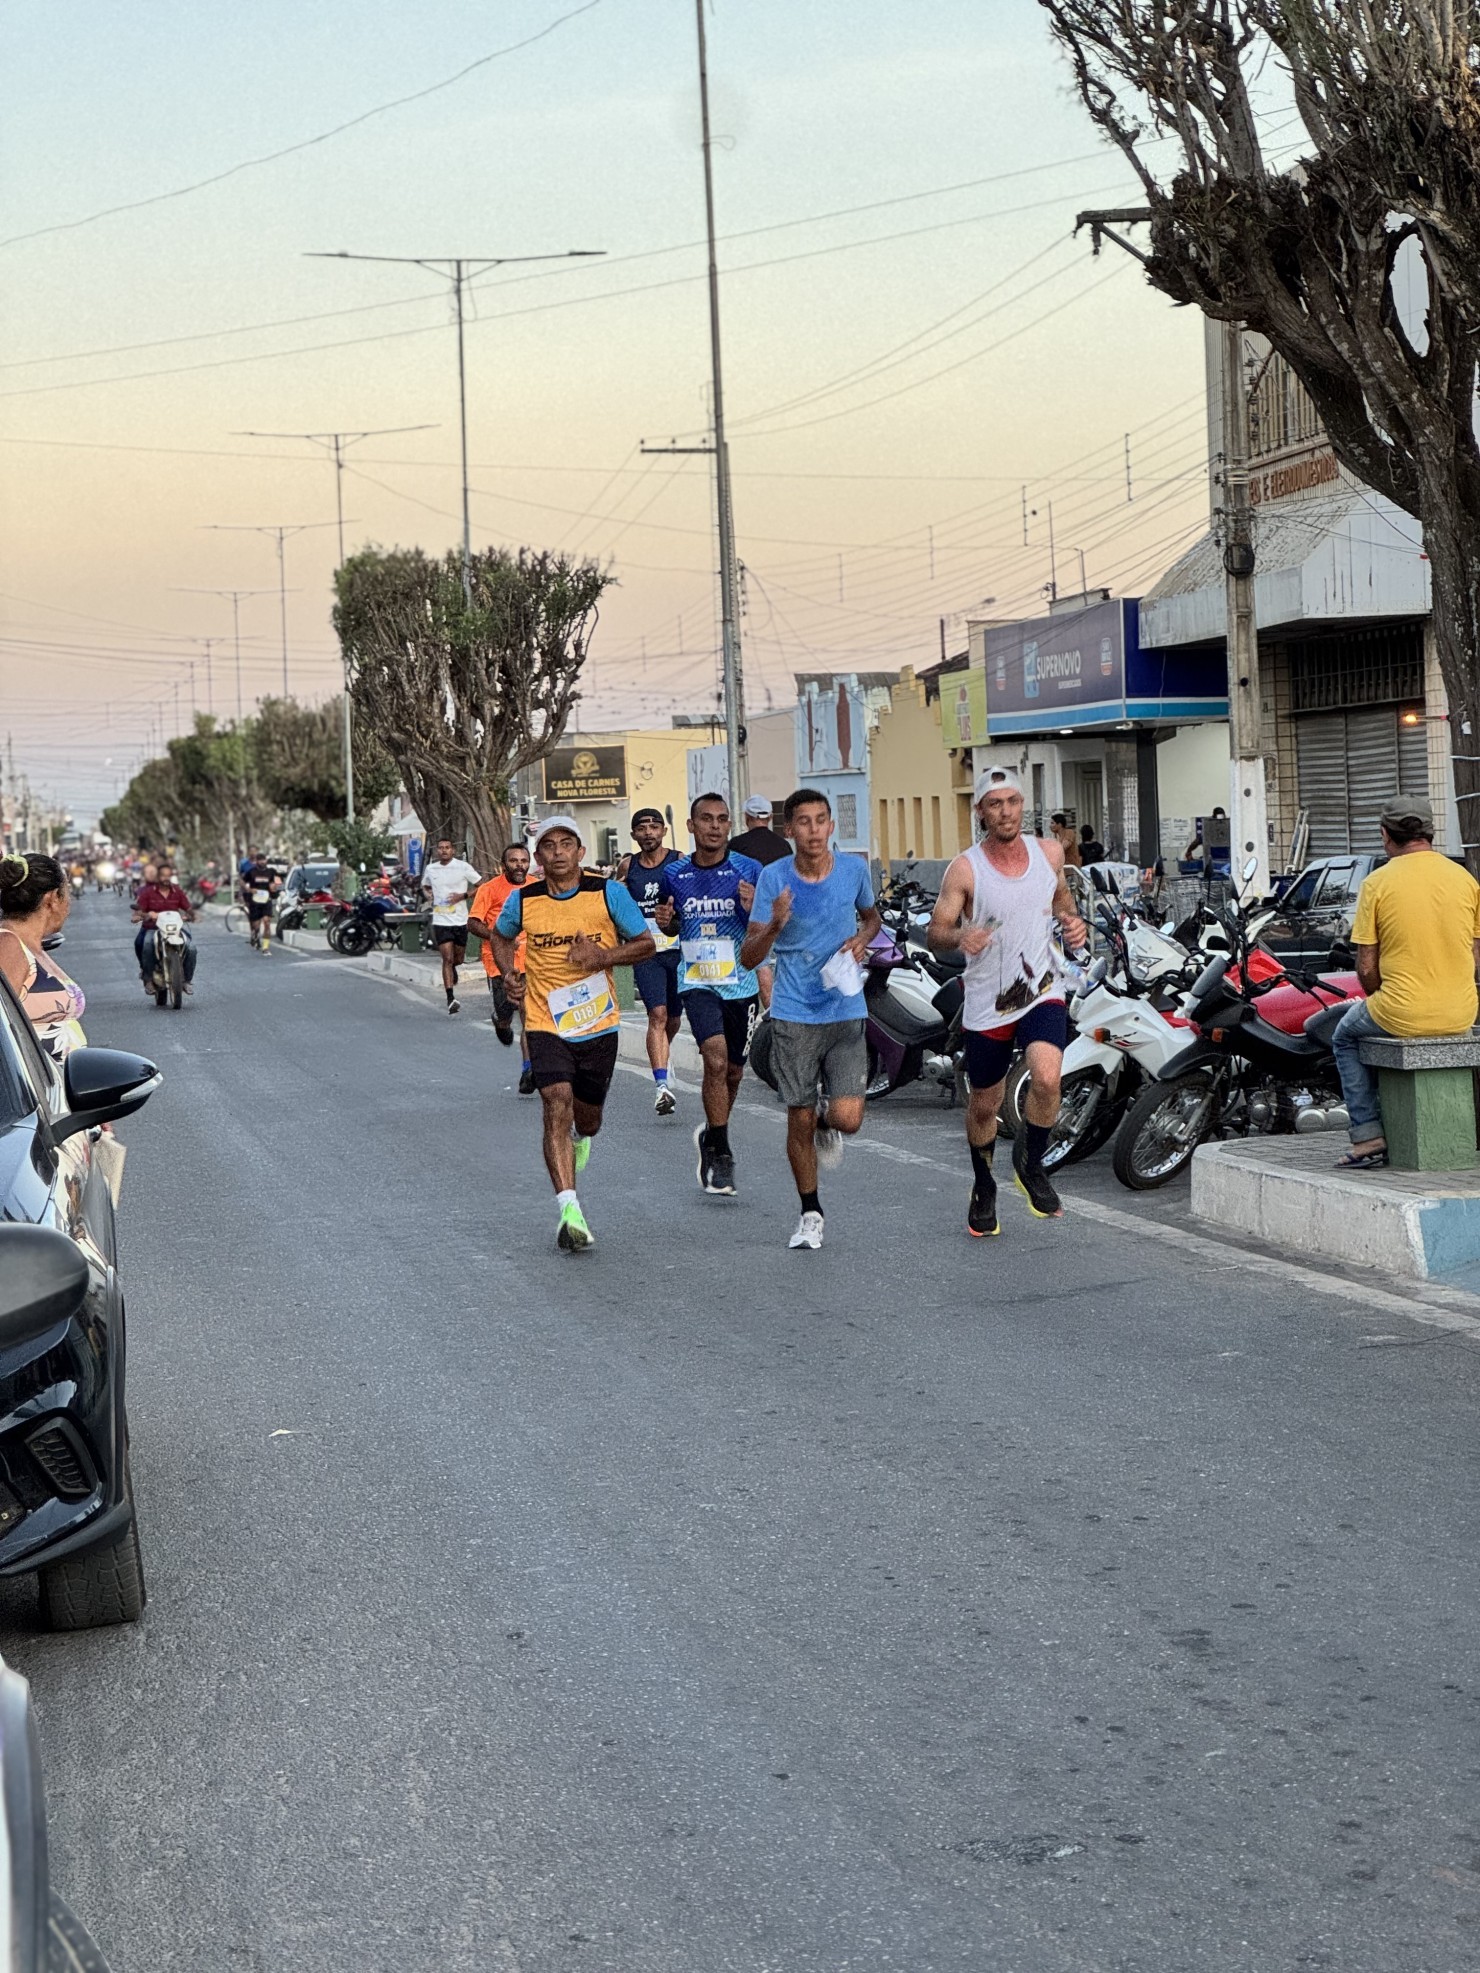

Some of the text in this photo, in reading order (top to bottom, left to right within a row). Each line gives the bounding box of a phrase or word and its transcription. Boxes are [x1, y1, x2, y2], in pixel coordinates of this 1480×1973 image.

[1037, 650, 1081, 680] SUPERNOVO
[551, 778, 621, 789] CASA DE CARNES
[557, 788, 617, 797] NOVA FLORESTA
[682, 895, 736, 911] Prime
[573, 1002, 597, 1023] 0187
